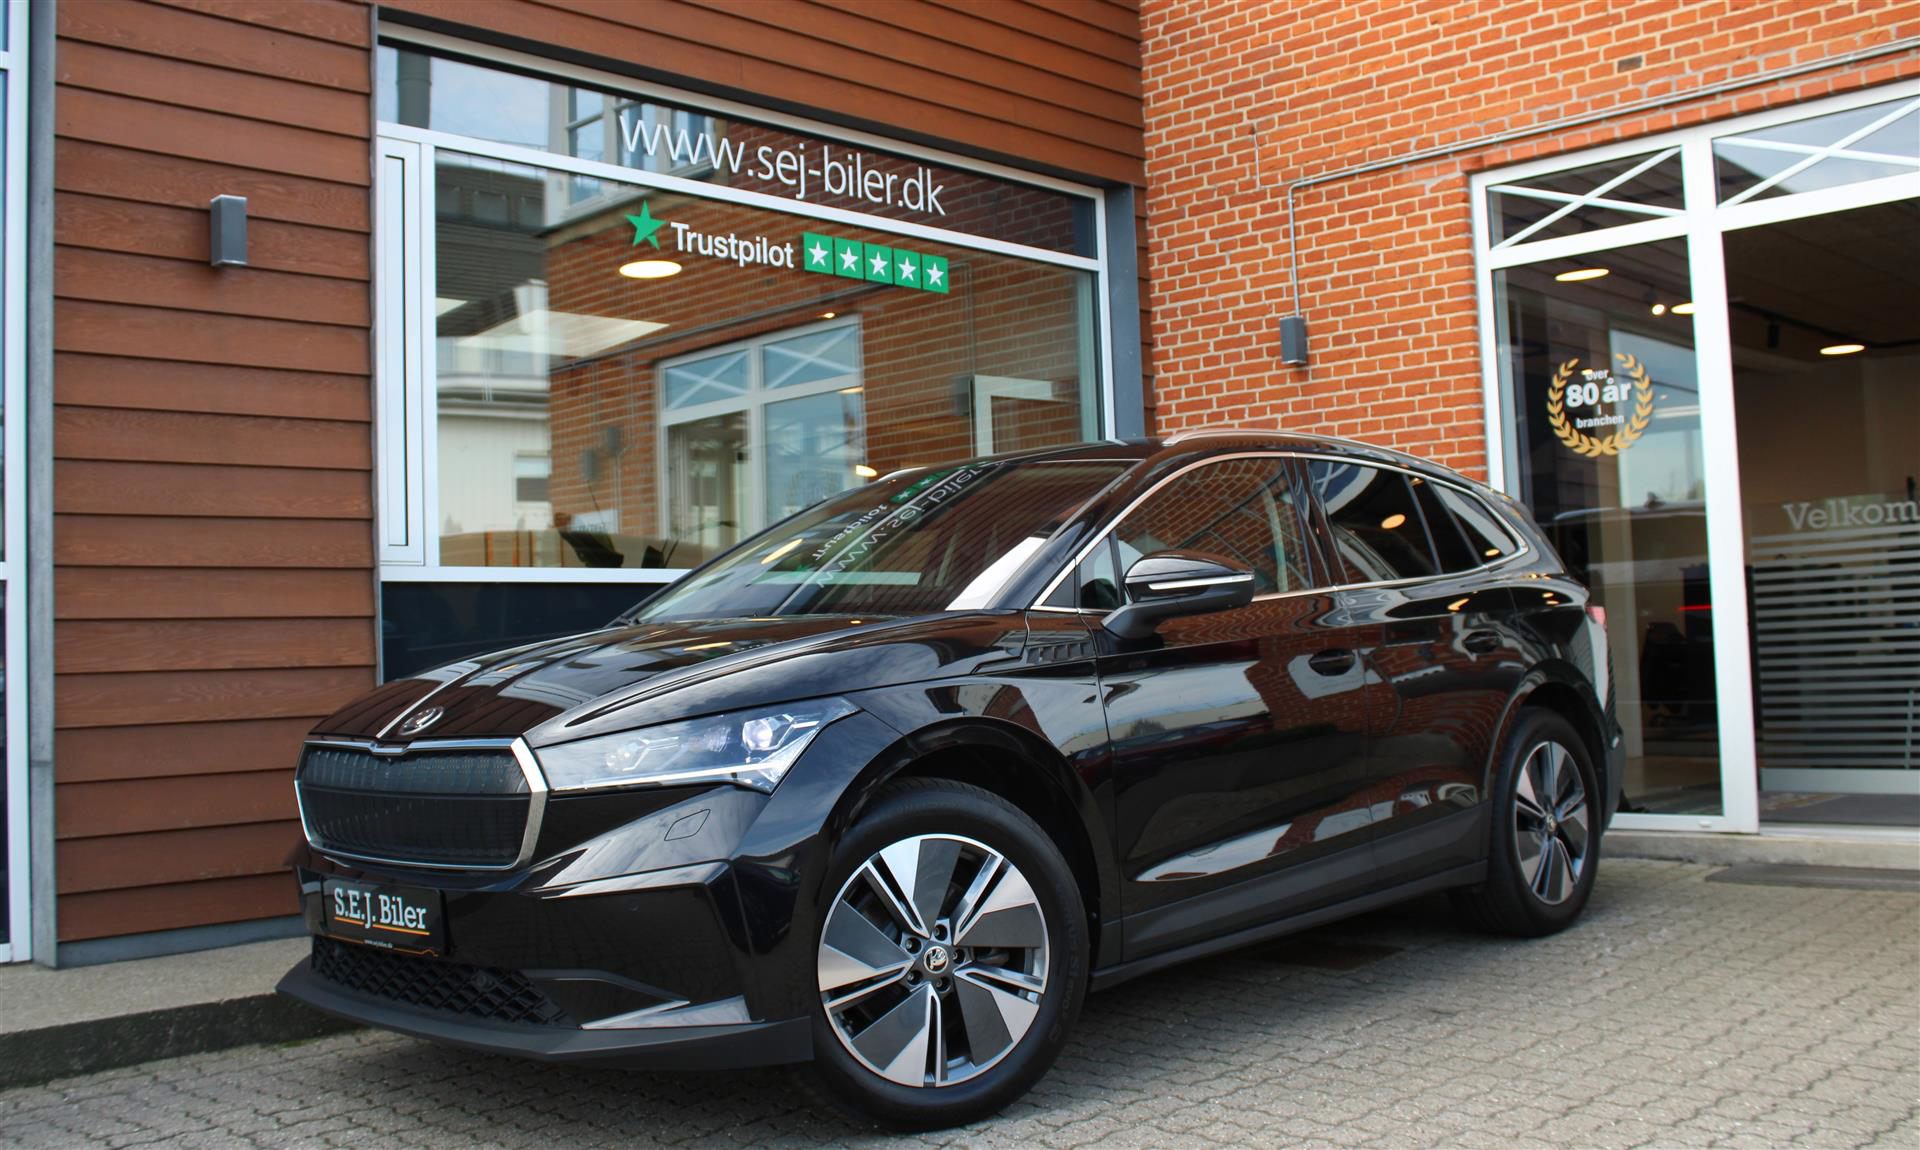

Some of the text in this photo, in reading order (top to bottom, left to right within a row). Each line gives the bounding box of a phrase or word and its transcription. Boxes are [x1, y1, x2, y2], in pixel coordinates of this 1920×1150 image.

[619, 115, 946, 216] www.sej-biler.dk
[670, 222, 794, 269] Trustpilot
[1566, 377, 1631, 408] 80 år
[1576, 414, 1624, 429] branchen
[1782, 499, 1920, 530] Velkom
[334, 887, 427, 930] S.E.J. Biler
